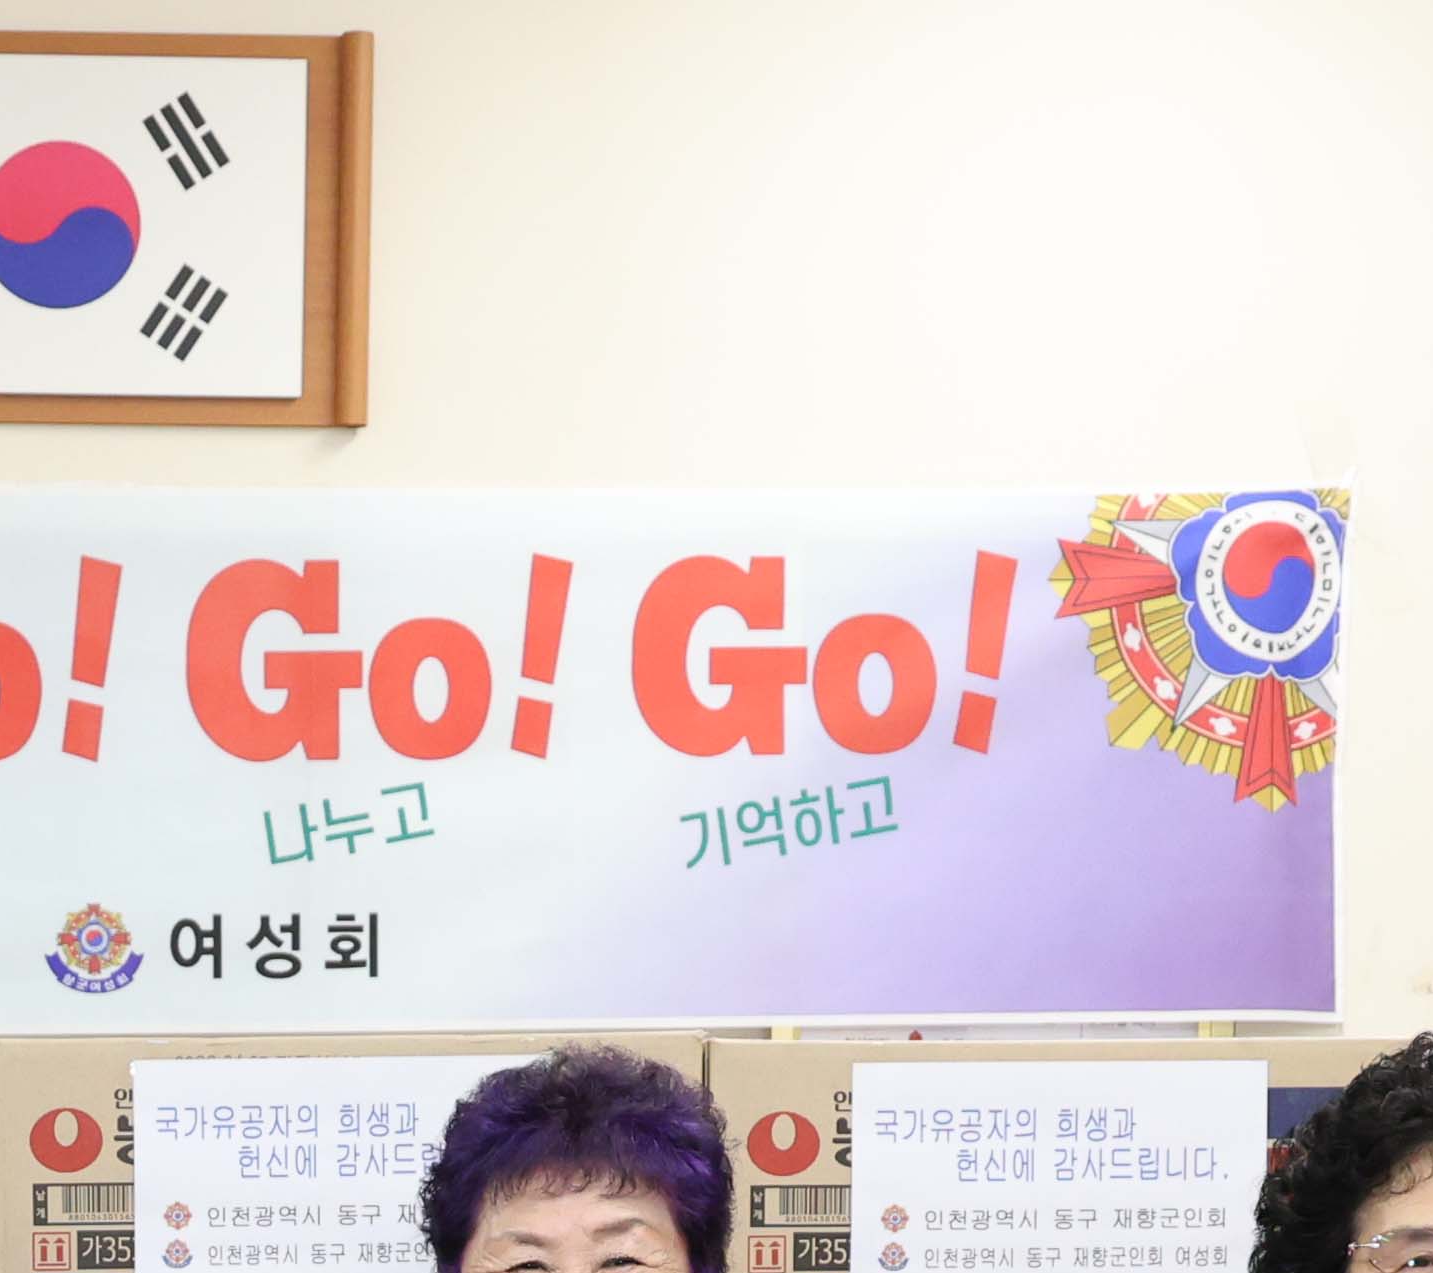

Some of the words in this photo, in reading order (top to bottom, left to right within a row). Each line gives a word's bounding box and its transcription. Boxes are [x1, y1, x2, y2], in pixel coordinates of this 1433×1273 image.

[186, 554, 573, 762] Go!
[631, 550, 1018, 757] Go!
[263, 782, 435, 864] 나누고
[680, 776, 899, 869] 기억하고
[156, 1104, 318, 1140] 국가유공자의
[338, 1103, 419, 1137] 희생과
[875, 1109, 1036, 1143] 국가유공자의
[1056, 1108, 1136, 1142] 희생과
[239, 1144, 316, 1178] 헌신에
[958, 1149, 1034, 1182] 헌신에
[1054, 1147, 1228, 1181] 감사드립니다.
[208, 1205, 320, 1227] 인천광역시
[338, 1205, 381, 1225] 동구
[925, 1209, 1037, 1230] 인천광역시
[1054, 1209, 1097, 1230] 동구
[1113, 1208, 1225, 1229] 재향군인회
[82, 1235, 134, 1265] 가35
[208, 1245, 297, 1266] 인천광역시
[311, 1244, 345, 1264] 동구
[798, 1237, 851, 1267] 가35
[924, 1248, 1013, 1269] 인천광역시
[1027, 1248, 1061, 1268] 동구
[1074, 1247, 1162, 1267] 재향군인회
[1176, 1246, 1227, 1267] 여성회
